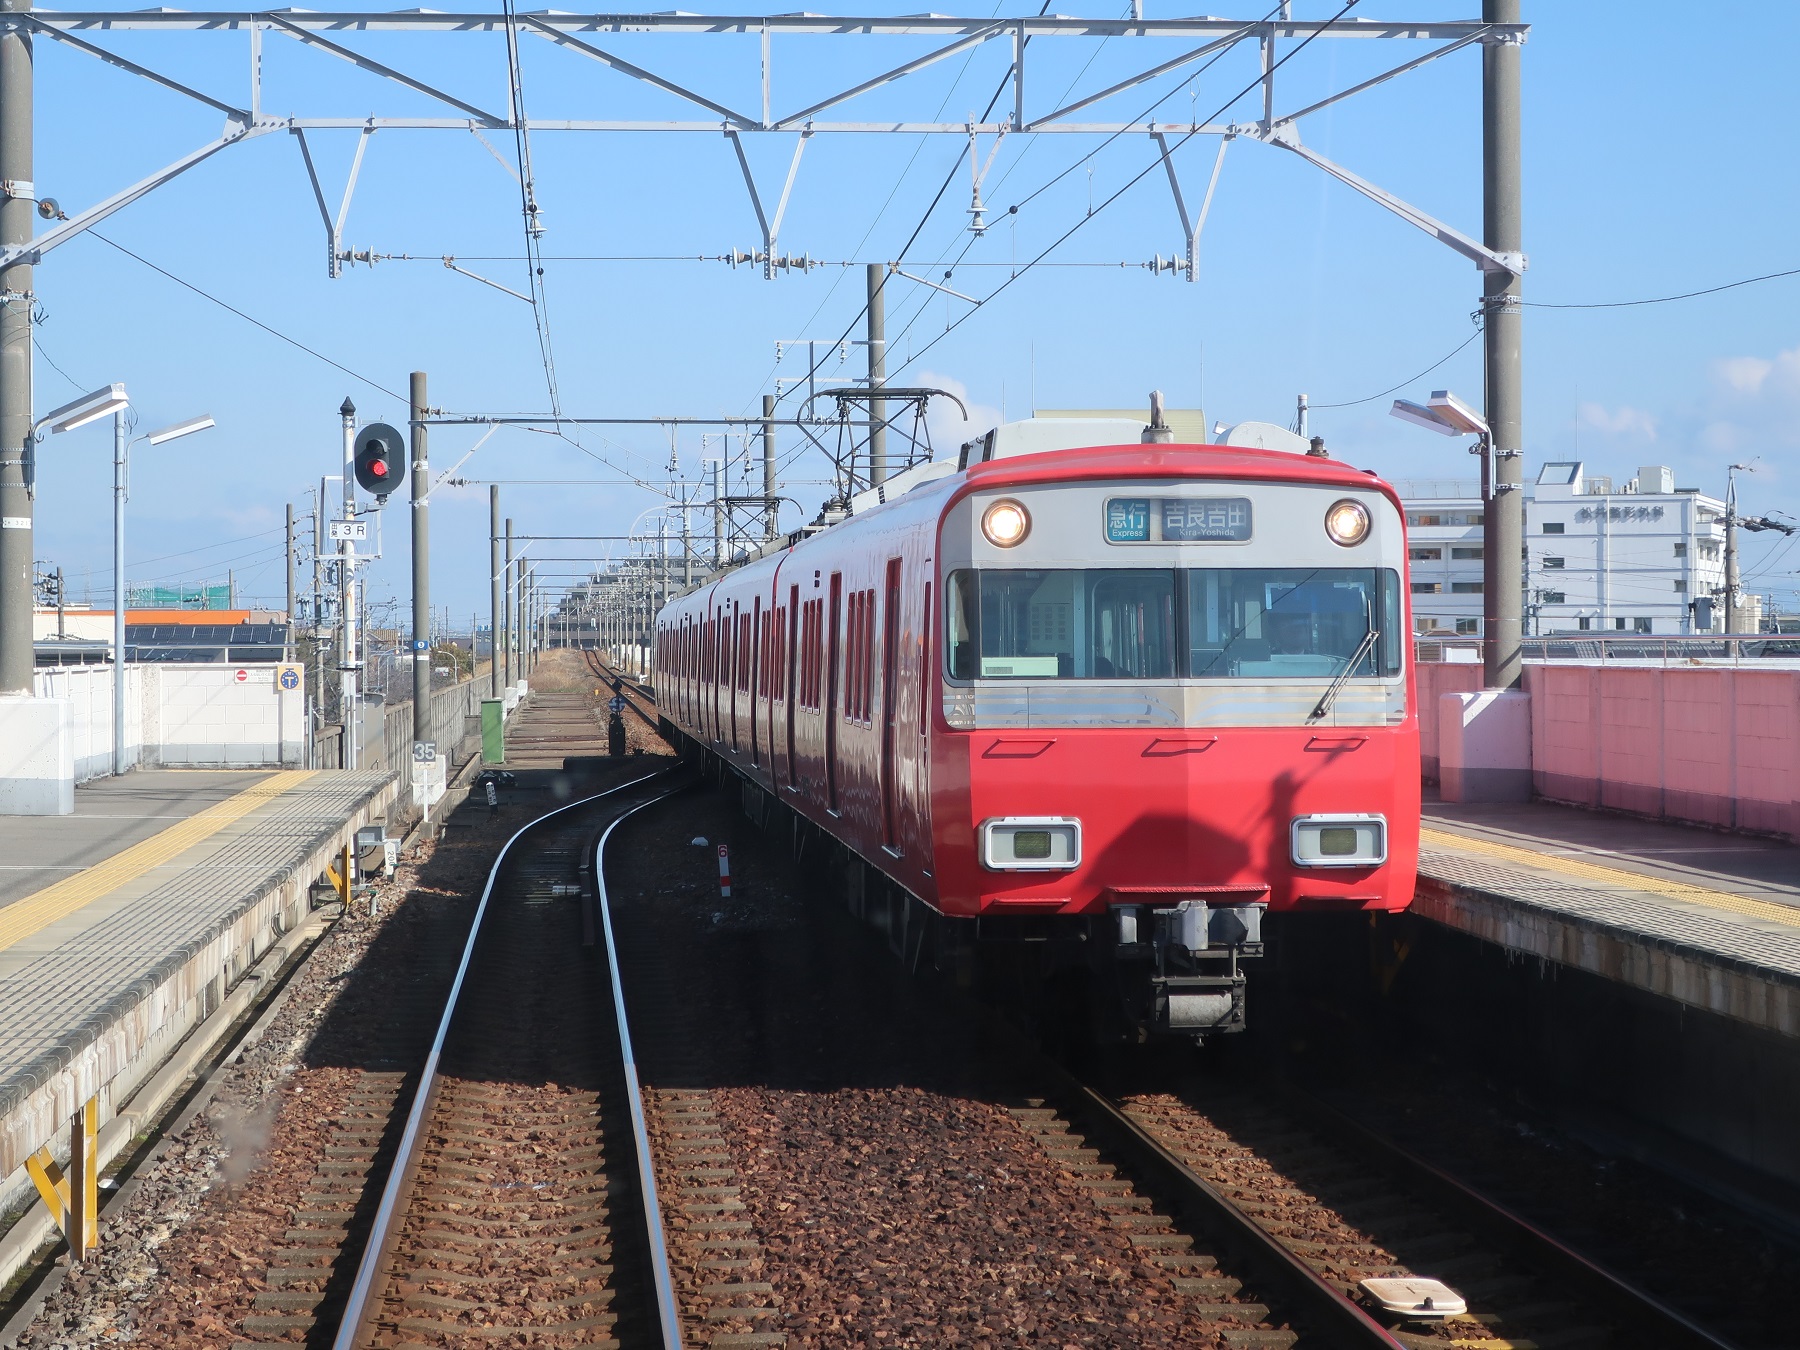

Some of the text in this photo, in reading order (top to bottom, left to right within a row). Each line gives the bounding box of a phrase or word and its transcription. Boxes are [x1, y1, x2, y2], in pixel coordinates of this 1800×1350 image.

[1110, 502, 1146, 529] 急行
[1165, 502, 1247, 529] 吉良吉田
[343, 525, 365, 535] 3 R
[1112, 529, 1144, 538] Express
[1179, 528, 1235, 537] Kira-Yoshida
[414, 743, 436, 760] 35
[718, 845, 727, 857] 6
